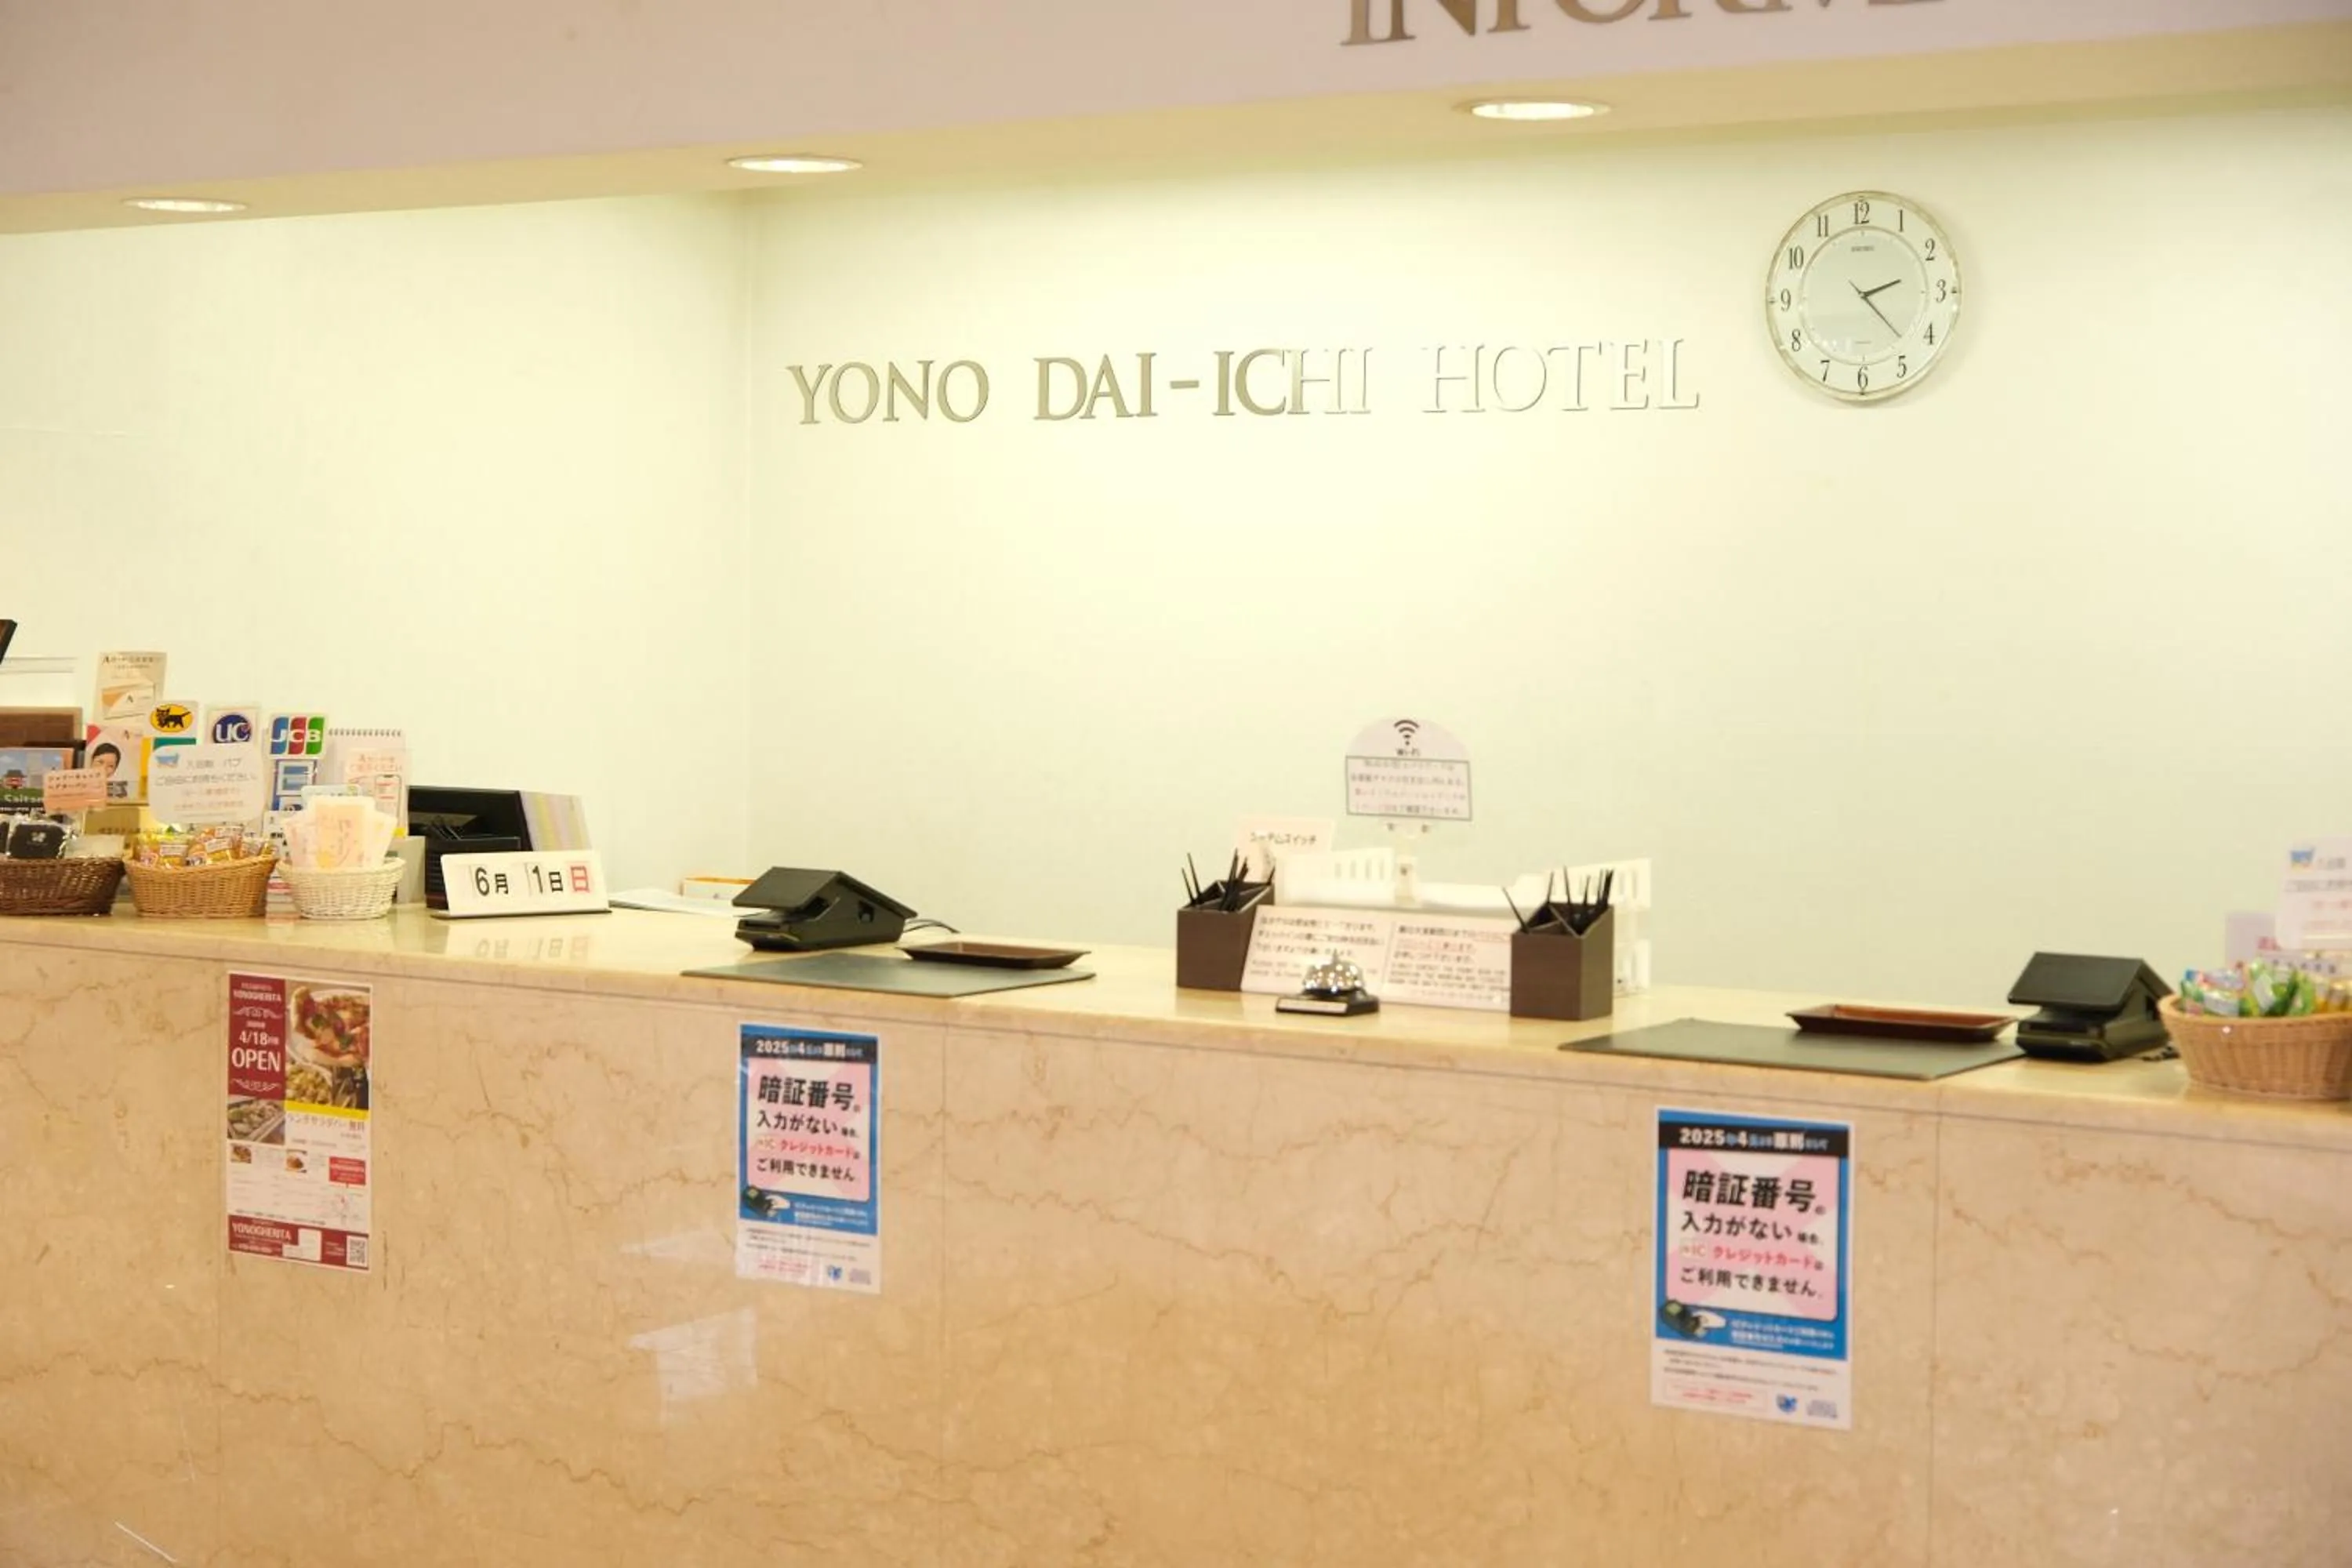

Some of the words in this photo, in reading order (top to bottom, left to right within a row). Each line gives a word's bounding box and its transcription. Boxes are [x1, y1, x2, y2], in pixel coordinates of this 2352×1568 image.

[1853, 201, 1871, 224] 12
[1897, 209, 1904, 232] 1
[1817, 215, 1829, 238] 11
[1788, 246, 1804, 270] 10
[1925, 238, 1936, 261] 2
[1780, 289, 1791, 312] 9
[1936, 279, 1947, 303] 3
[1791, 329, 1802, 352] 8
[1923, 323, 1936, 346] 4
[1820, 360, 1831, 382] 7
[1857, 365, 1868, 390] 6
[1896, 355, 1907, 378] 5
[786, 360, 989, 425] YONO
[1033, 346, 1374, 421] DAI-ICHI
[1421, 339, 1700, 413] HOTEL
[216, 722, 250, 743] UC
[474, 866, 510, 897] 6月
[532, 865, 564, 894] 1日
[570, 865, 590, 894] 日
[231, 1047, 281, 1073] OPEN
